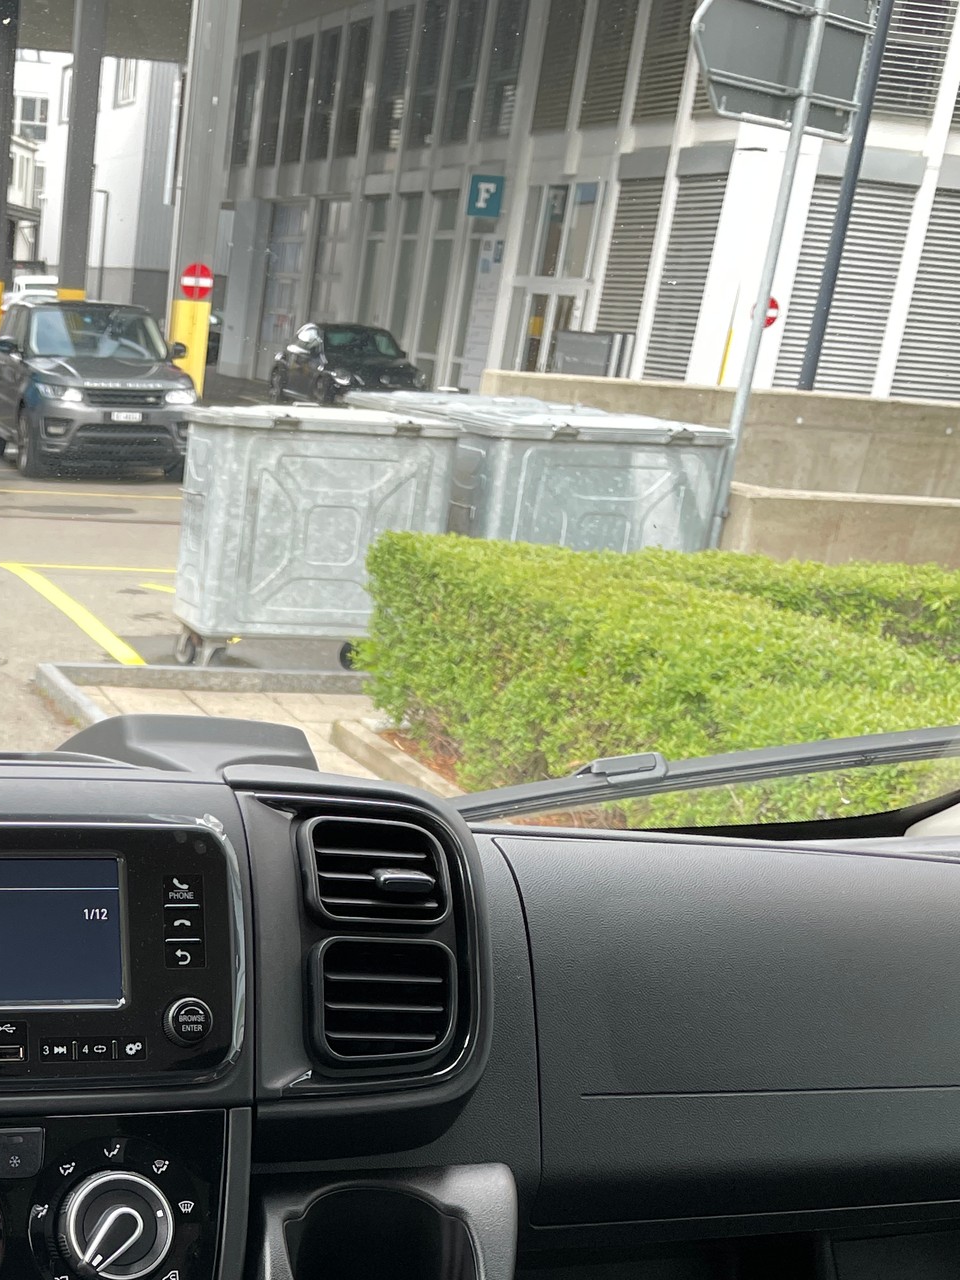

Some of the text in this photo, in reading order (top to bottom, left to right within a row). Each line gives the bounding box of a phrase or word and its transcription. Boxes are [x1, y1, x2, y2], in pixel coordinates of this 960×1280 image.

[475, 182, 497, 208] F
[168, 891, 194, 900] PHONE
[83, 908, 108, 920] 1/12
[178, 1014, 205, 1023] BROWSE
[181, 1024, 203, 1033] ENTER
[42, 1045, 50, 1056] 3
[82, 1044, 89, 1054] 4
